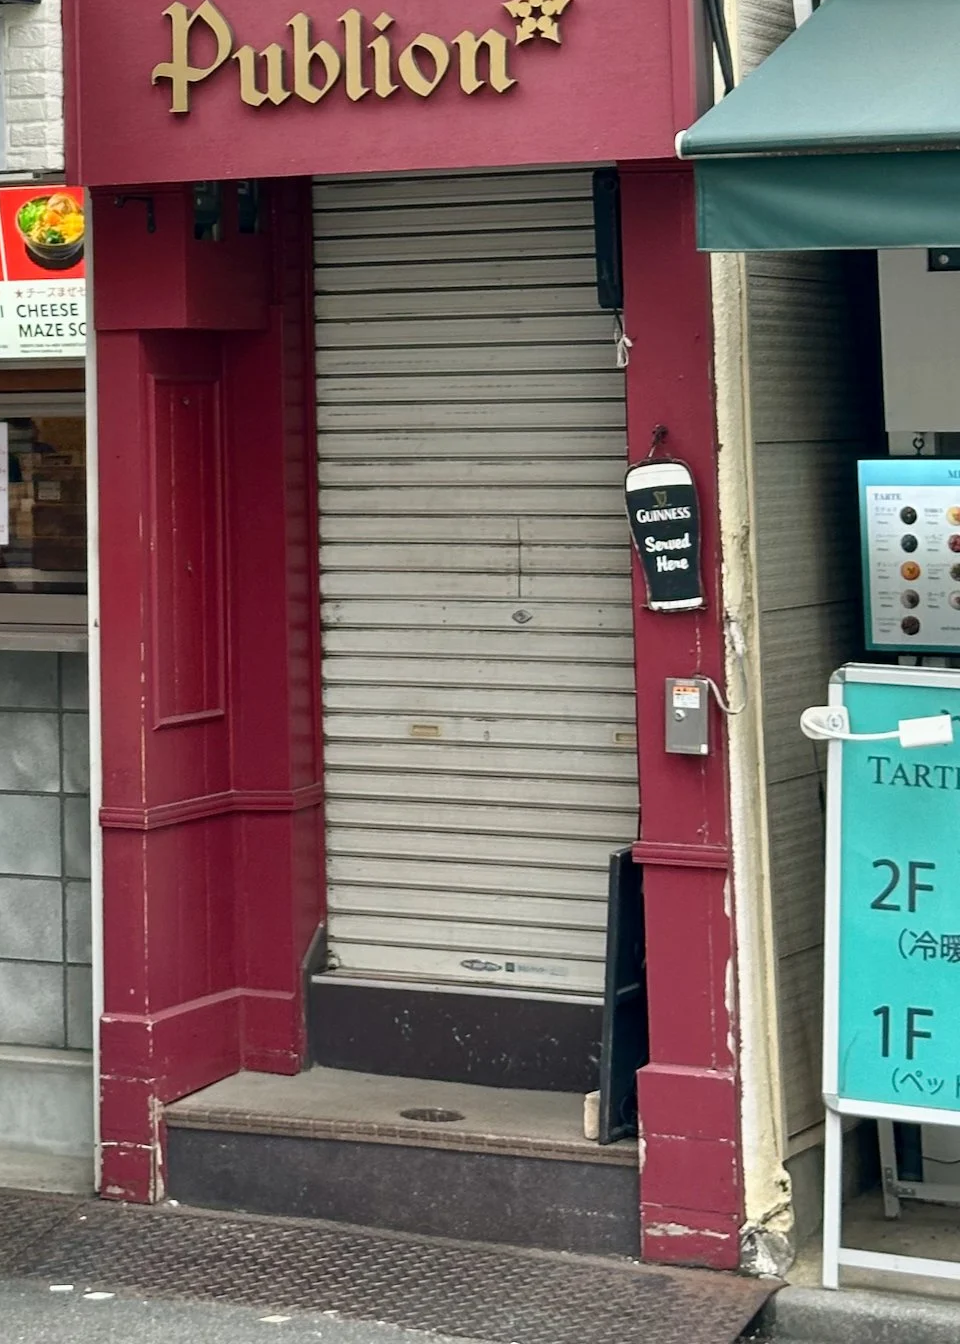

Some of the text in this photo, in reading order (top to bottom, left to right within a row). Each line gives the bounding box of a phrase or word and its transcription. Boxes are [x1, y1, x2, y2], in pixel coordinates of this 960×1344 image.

[151, 0, 518, 114] Publion
[16, 303, 79, 318] CHEESE
[19, 323, 64, 338] MAZE
[636, 506, 692, 523] GUINNESS
[645, 532, 692, 553] Served
[656, 555, 689, 572] Here
[870, 857, 936, 913] 2F
[873, 1004, 934, 1060] 1F
